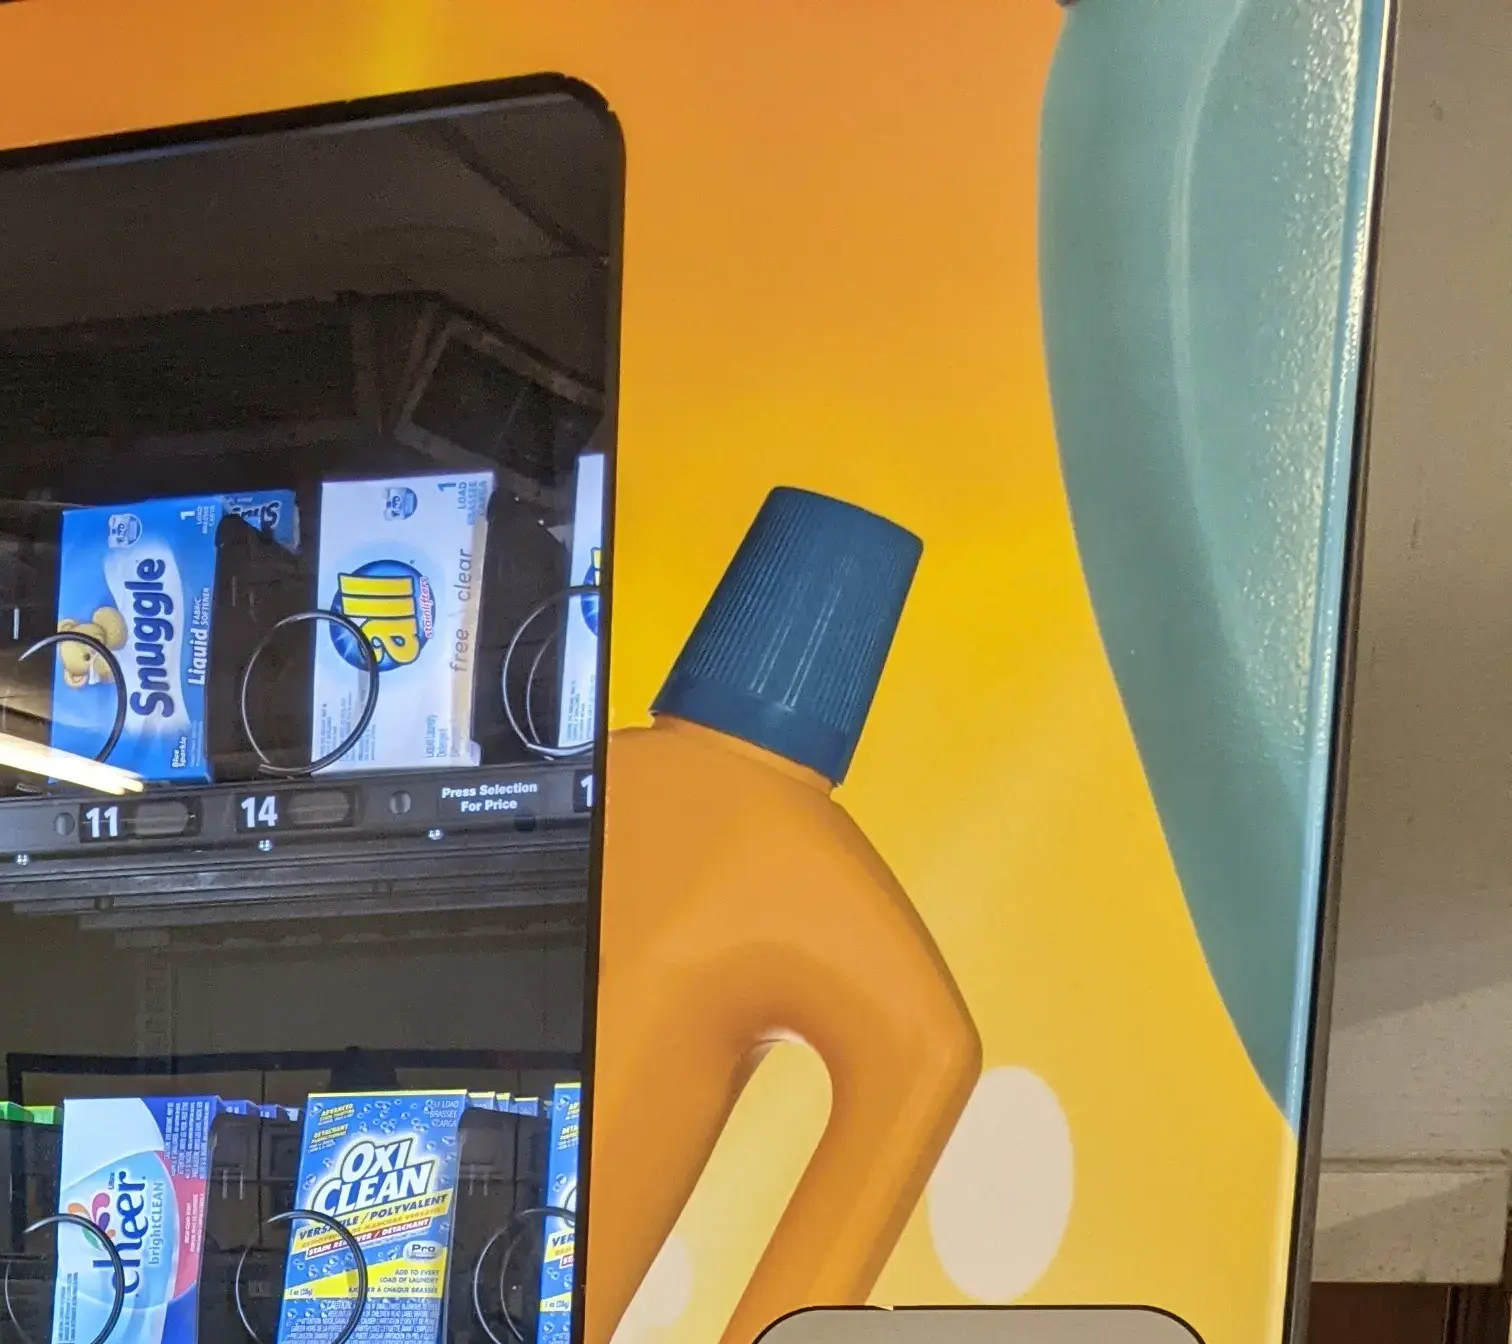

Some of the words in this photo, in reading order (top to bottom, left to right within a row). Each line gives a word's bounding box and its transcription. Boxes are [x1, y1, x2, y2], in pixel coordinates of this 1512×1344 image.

[454, 548, 473, 602] clear
[124, 557, 175, 718] Snuggle
[338, 572, 420, 666] all
[188, 628, 209, 686] Liquid
[450, 628, 470, 673] free
[86, 806, 119, 838] 11
[242, 796, 278, 828] 14
[441, 786, 476, 800] Press
[479, 781, 538, 796] Selection
[460, 800, 485, 813] For
[487, 798, 518, 811] Price
[340, 1137, 414, 1183] OXI
[312, 1160, 436, 1218] CLEAN
[370, 1194, 447, 1220] POLYVALENT
[92, 1170, 150, 1296] cheer
[149, 1180, 166, 1266] brightCLEAN
[411, 1244, 436, 1254] Pro
